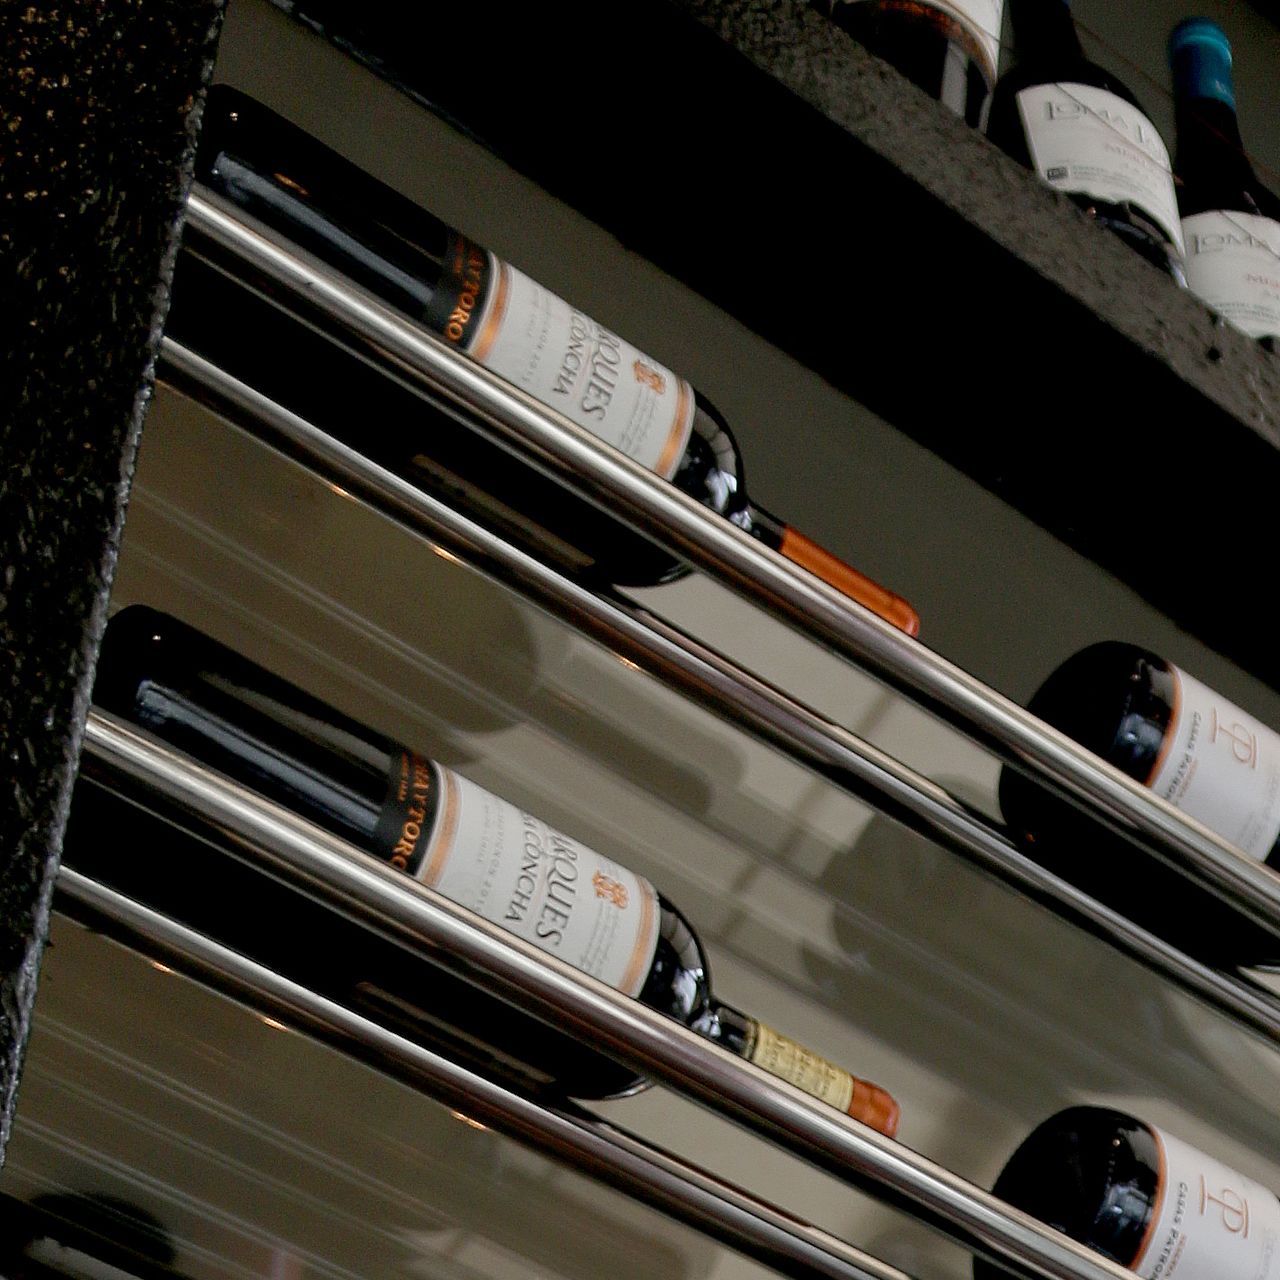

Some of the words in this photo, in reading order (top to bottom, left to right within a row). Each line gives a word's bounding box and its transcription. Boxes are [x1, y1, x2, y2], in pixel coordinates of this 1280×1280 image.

[579, 325, 620, 422] RQUES
[503, 830, 540, 924] CONCHA
[534, 833, 575, 946] ARQUES
